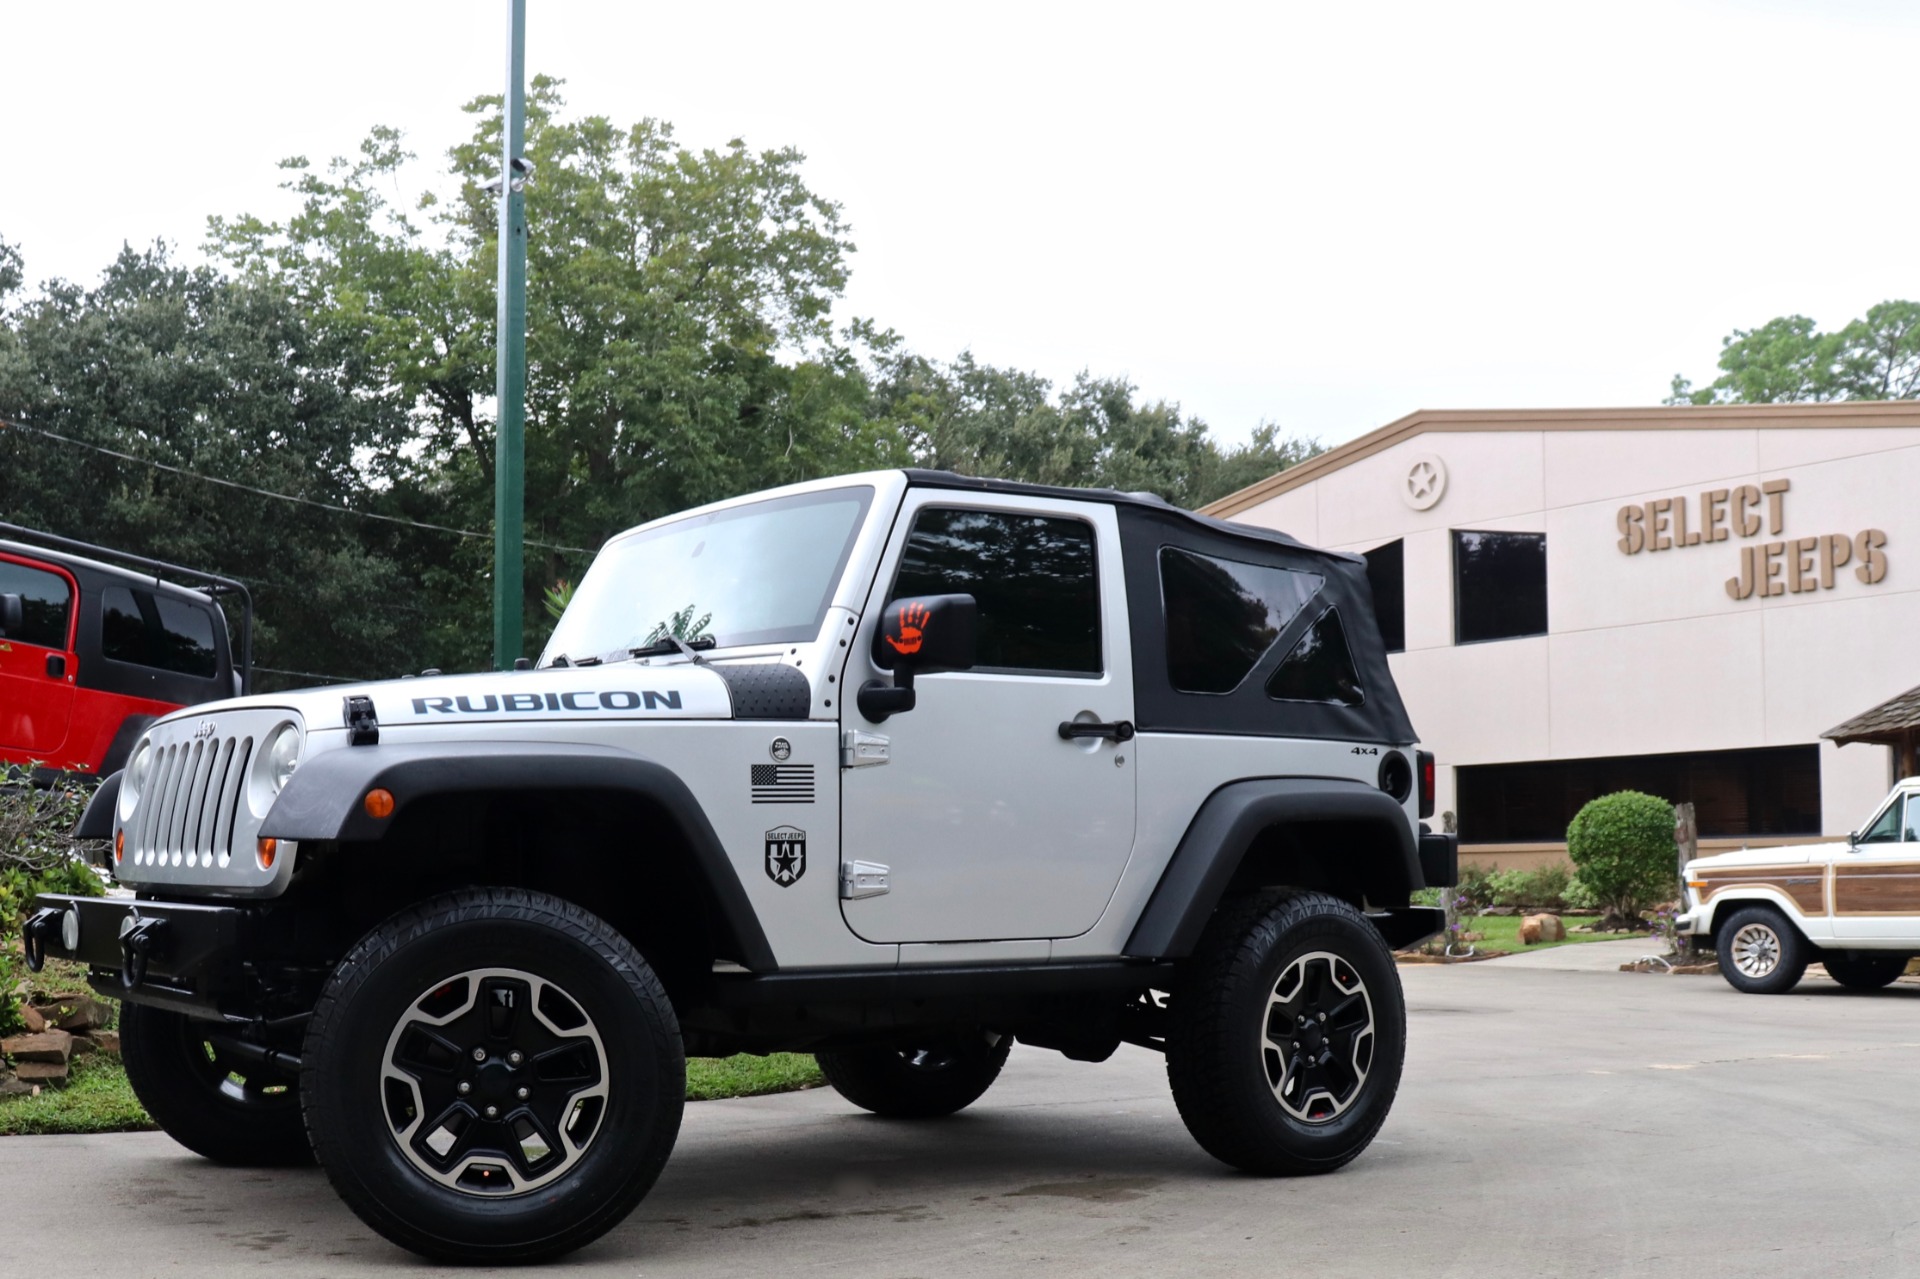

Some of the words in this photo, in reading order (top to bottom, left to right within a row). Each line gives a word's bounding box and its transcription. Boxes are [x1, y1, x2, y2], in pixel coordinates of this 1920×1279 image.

[1616, 477, 1791, 556] SELECT
[1724, 528, 1889, 601] JEEPS
[411, 689, 683, 715] RUBICON
[193, 719, 218, 740] Jeep
[767, 832, 787, 840] SELECT
[787, 832, 804, 840] JEEPS
